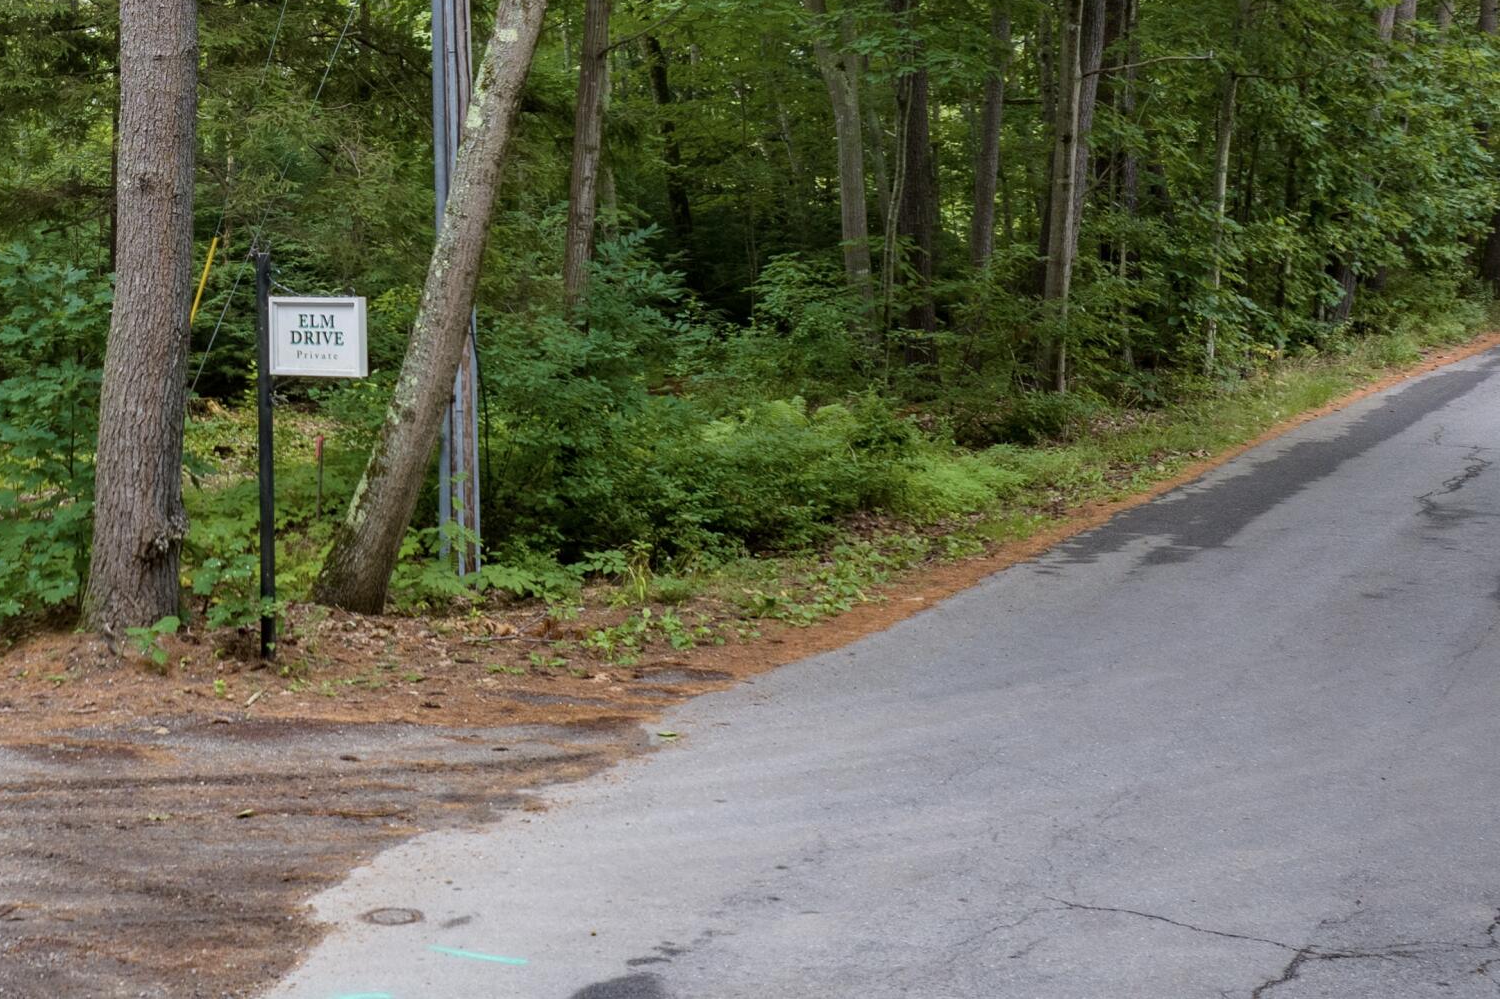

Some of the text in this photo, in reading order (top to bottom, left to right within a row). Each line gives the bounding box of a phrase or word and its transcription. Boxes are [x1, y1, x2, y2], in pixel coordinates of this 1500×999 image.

[298, 313, 335, 329] ELM
[290, 330, 345, 346] DRIVE
[296, 350, 339, 360] Private
